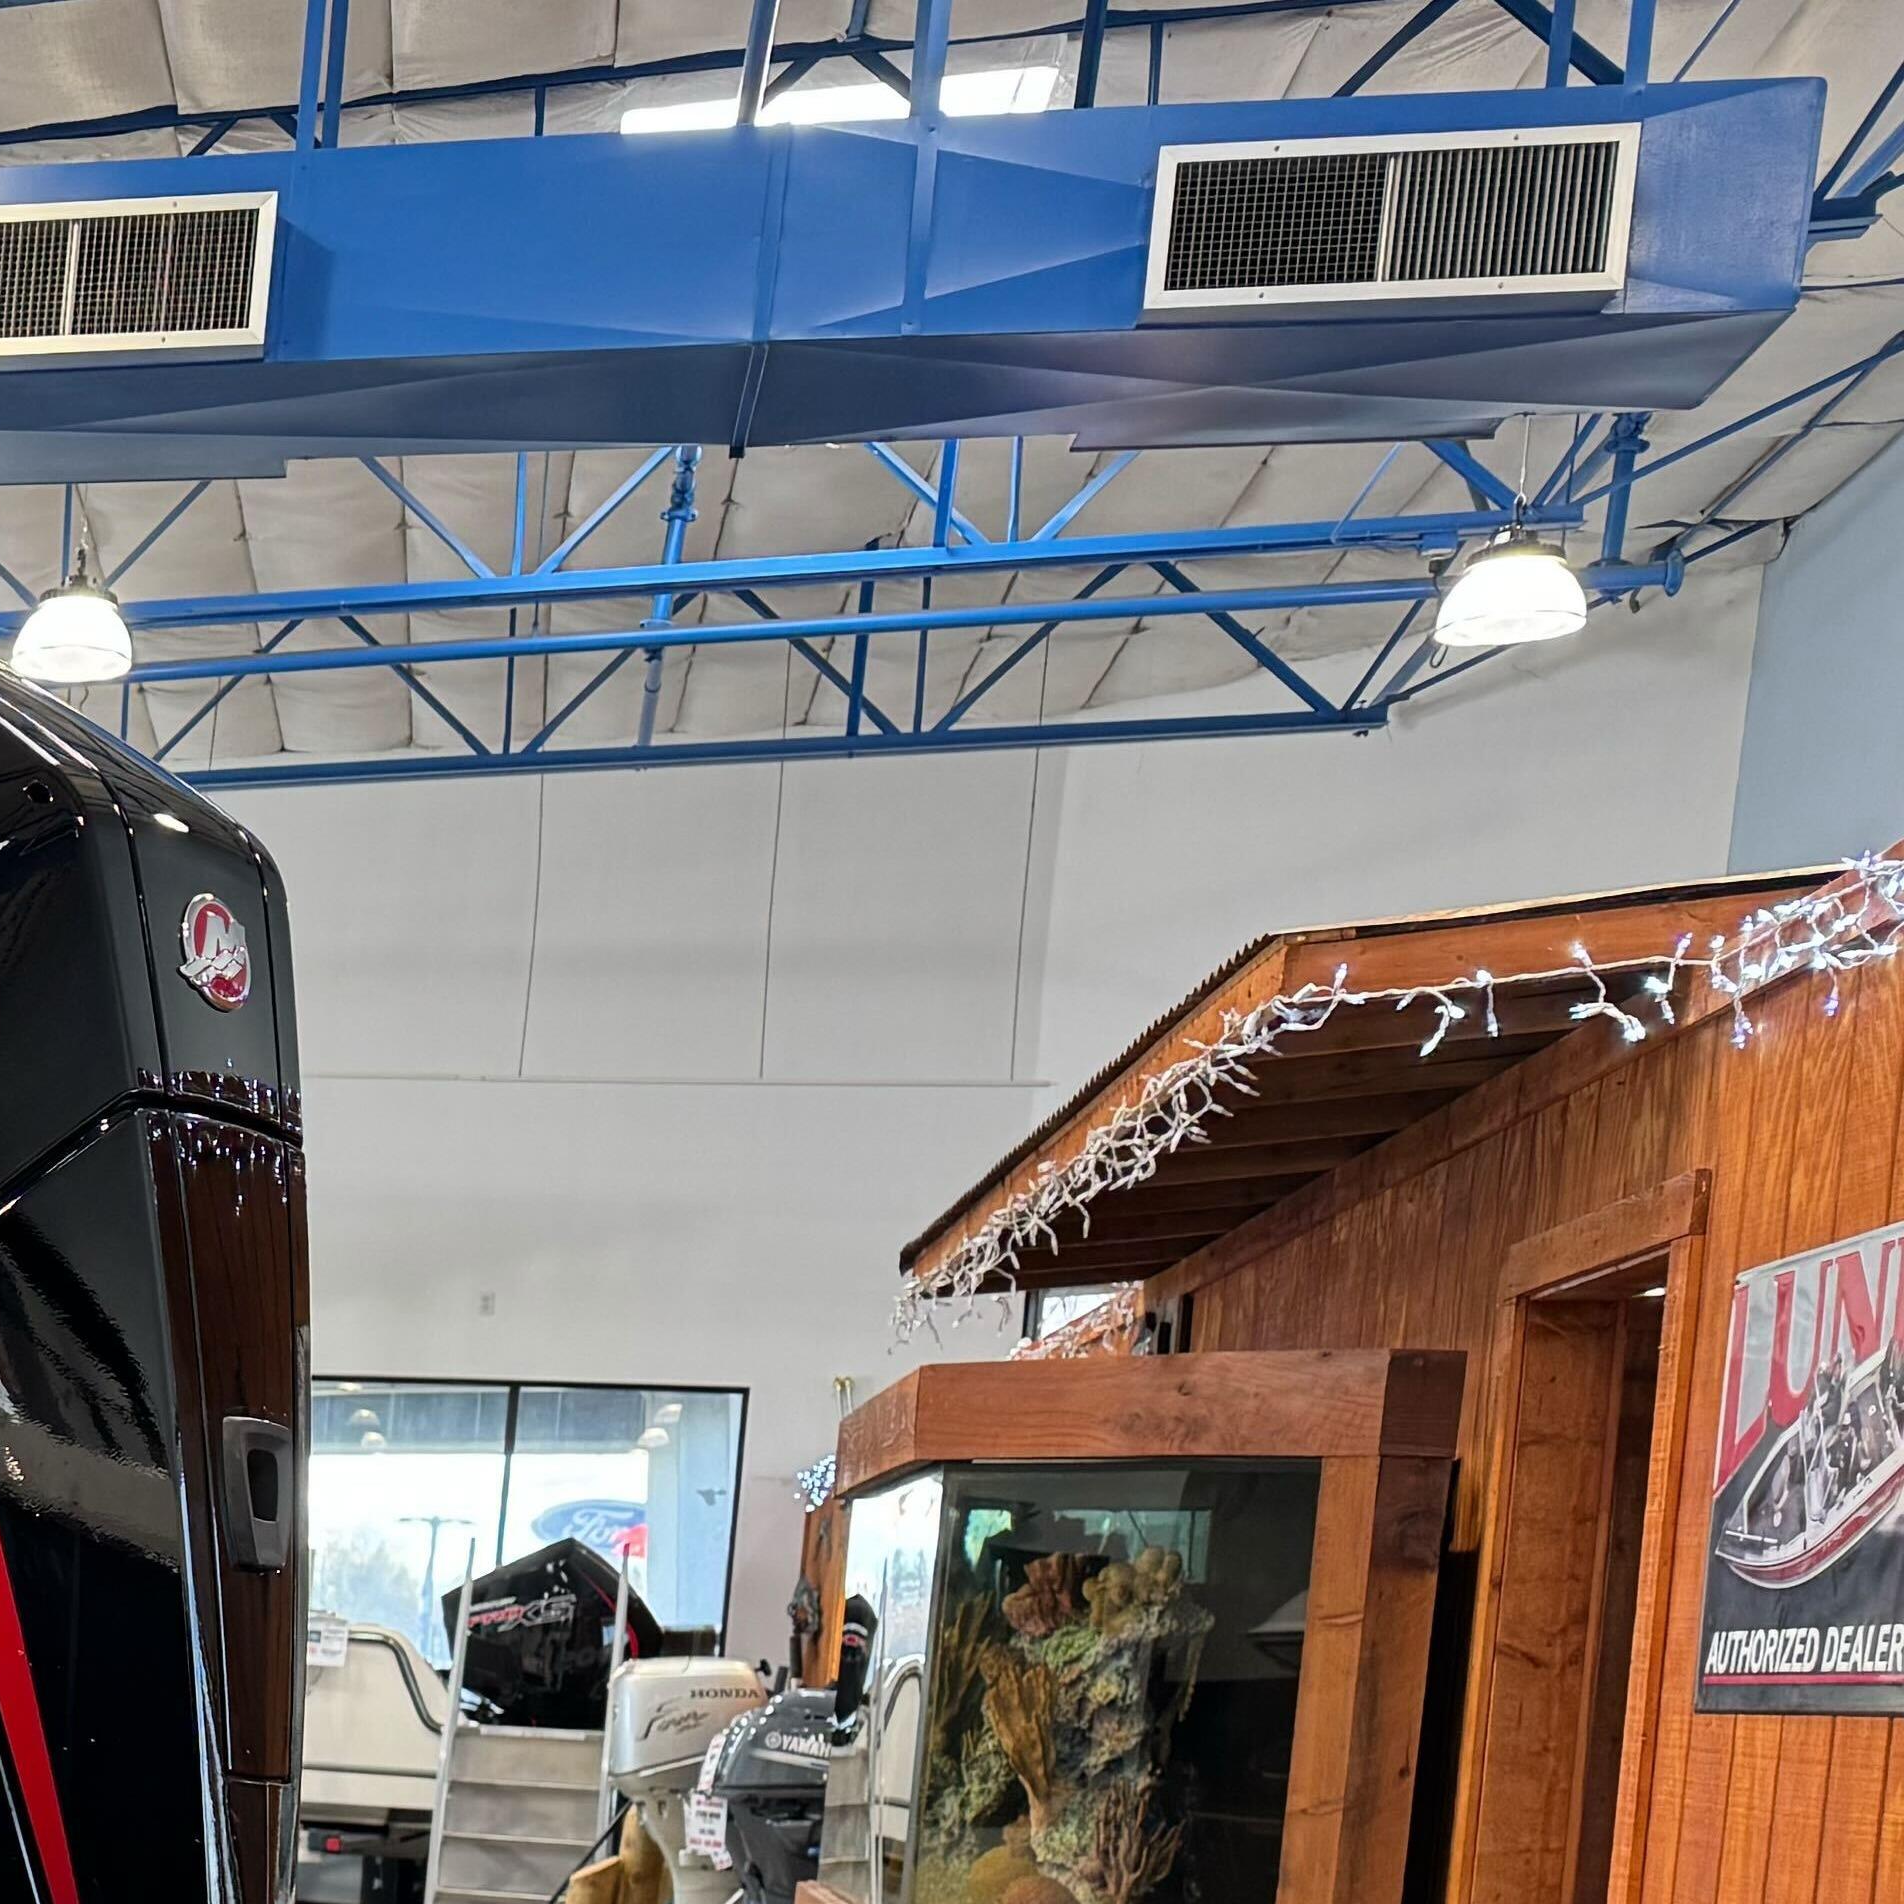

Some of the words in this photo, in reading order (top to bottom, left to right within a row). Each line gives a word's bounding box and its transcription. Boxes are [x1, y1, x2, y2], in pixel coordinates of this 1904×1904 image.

[1713, 1237, 1904, 1496] LUN
[1704, 1627, 1820, 1674] AUTHORIZED
[1821, 1623, 1904, 1673] DEALER
[690, 1687, 761, 1700] HONDA
[781, 1734, 833, 1758] YAMAH
